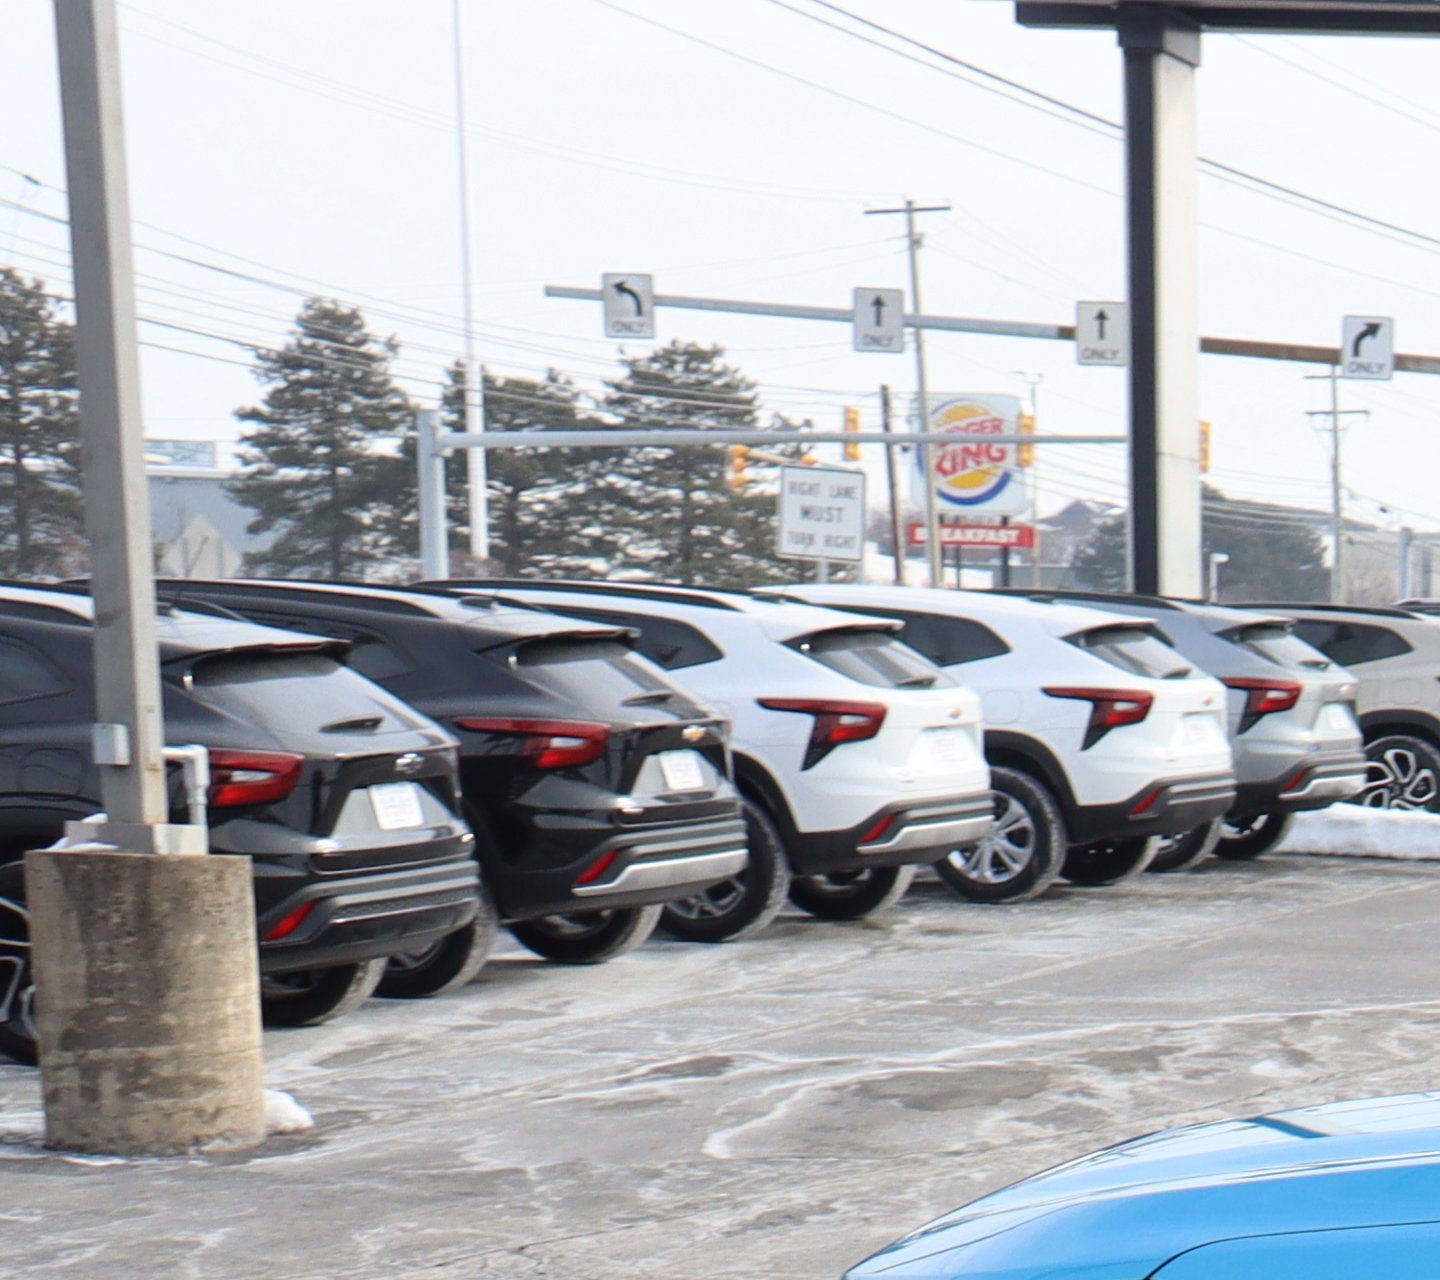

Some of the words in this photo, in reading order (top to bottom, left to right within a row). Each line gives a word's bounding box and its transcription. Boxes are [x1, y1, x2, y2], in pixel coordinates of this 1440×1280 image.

[611, 321, 645, 333] ONLY
[862, 333, 895, 347] ONLY
[1081, 347, 1120, 361] ONLY
[1348, 361, 1386, 374] ONLY
[801, 505, 844, 523] MUST
[914, 526, 1020, 543] BEAKFAST
